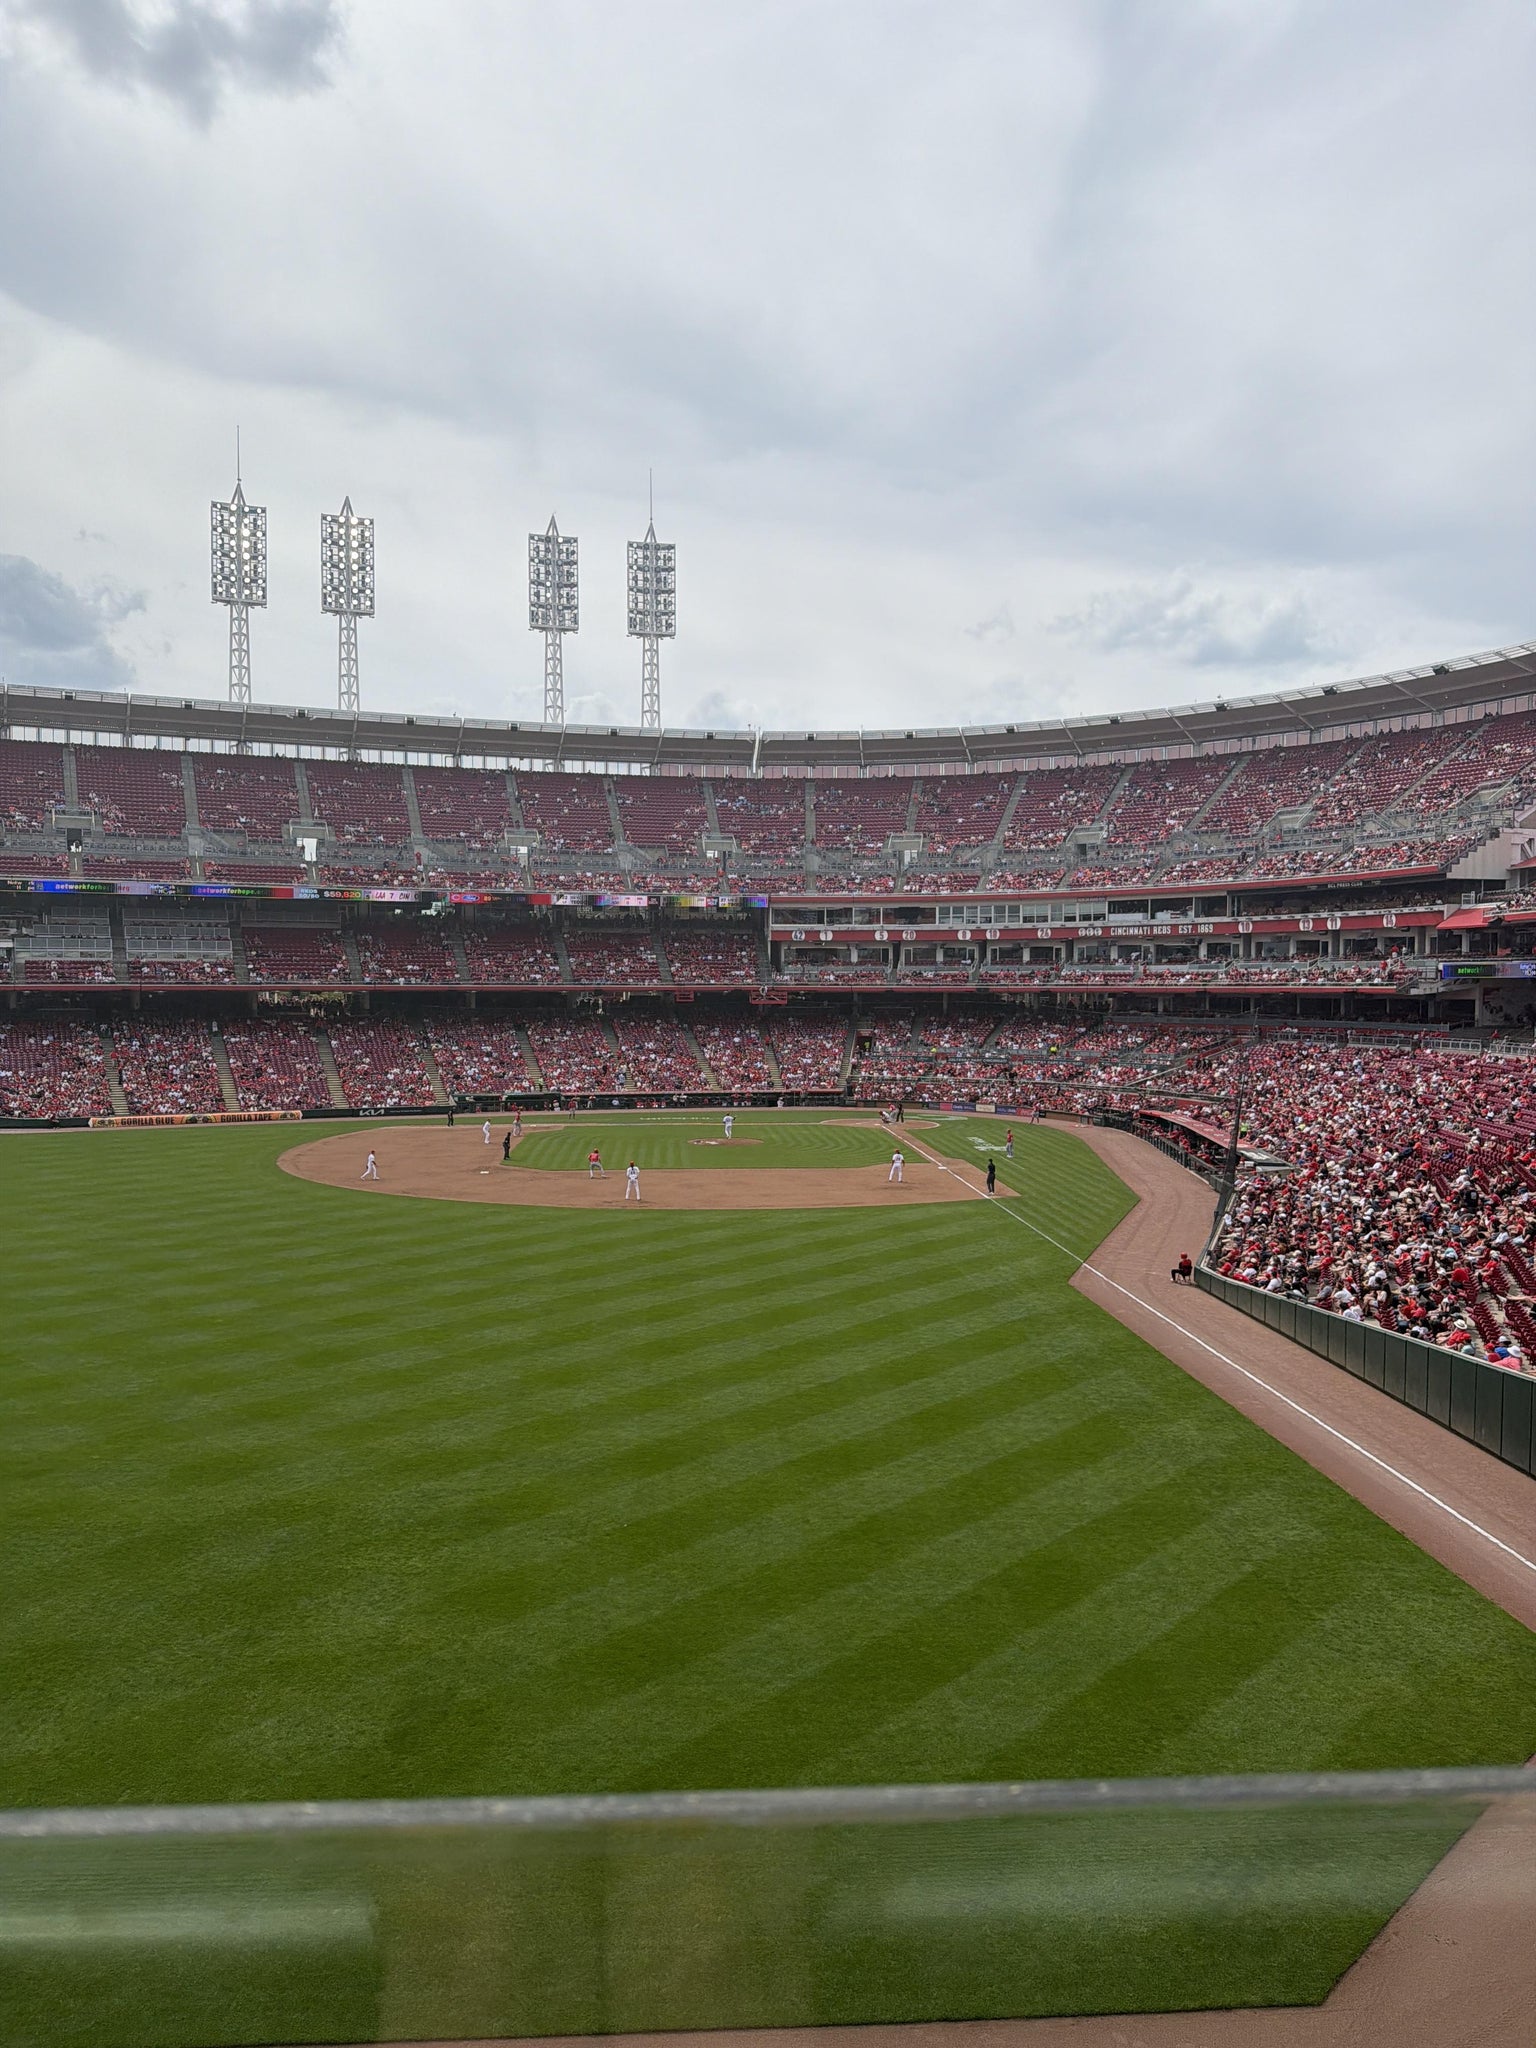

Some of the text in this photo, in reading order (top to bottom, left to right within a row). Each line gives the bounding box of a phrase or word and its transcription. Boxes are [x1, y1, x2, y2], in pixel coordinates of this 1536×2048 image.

[398, 892, 411, 900] CIN
[1240, 922, 1250, 933] 10
[1301, 919, 1311, 930] 13
[1329, 918, 1338, 930] 11
[1110, 923, 1213, 936] CINCINNATI REDS EST. 1869
[793, 931, 804, 940] 42
[904, 930, 915, 940] 20
[120, 1116, 175, 1126] GORILLA GLUE
[220, 1113, 272, 1122] GORILLA TAPE
